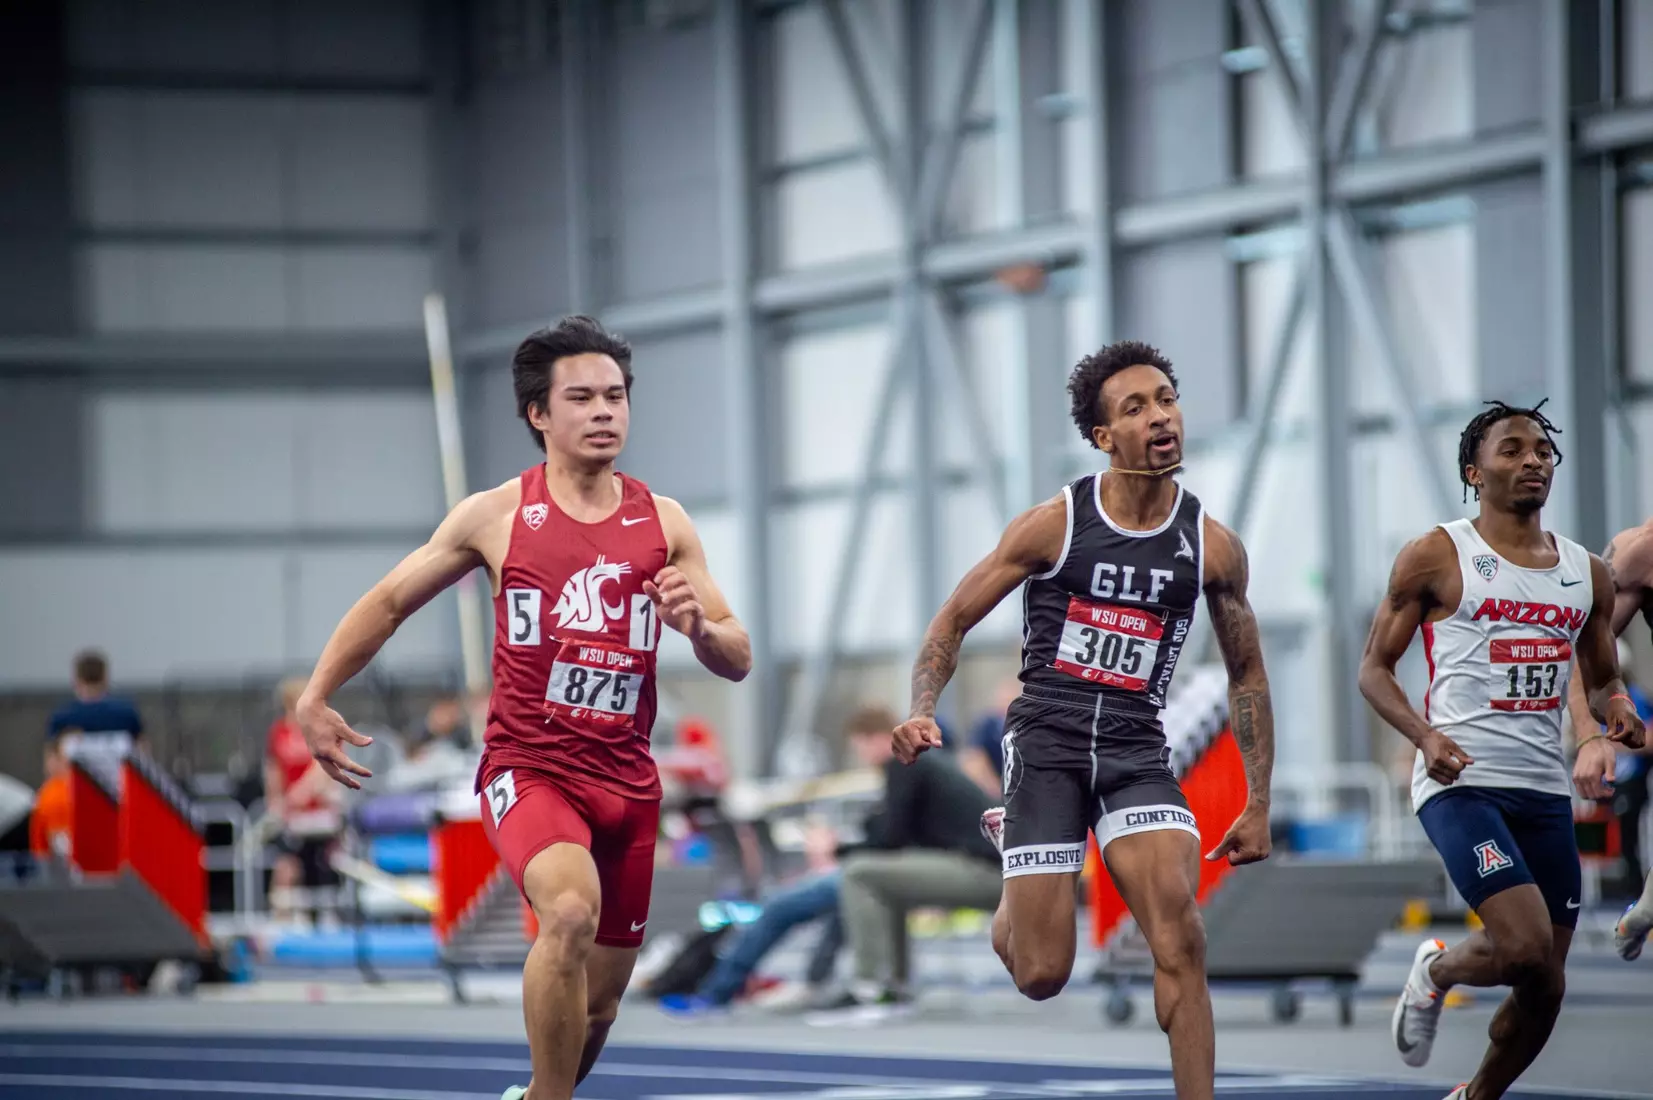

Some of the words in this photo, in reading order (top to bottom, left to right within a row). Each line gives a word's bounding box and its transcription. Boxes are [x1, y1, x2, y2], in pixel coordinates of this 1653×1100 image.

[528, 513, 543, 525] 12
[1090, 562, 1174, 603] GLF
[1482, 568, 1493, 577] 12
[513, 592, 532, 642] 5
[639, 598, 652, 648] 1
[1091, 607, 1118, 626] WSU
[1119, 614, 1148, 632] OPEN
[579, 647, 605, 664] WSU
[607, 650, 634, 668] OPEN
[1074, 627, 1146, 675] 305
[1511, 645, 1534, 658] WSU
[1537, 645, 1558, 658] OPEN
[564, 667, 631, 711] 875
[1506, 664, 1558, 698] 153
[491, 775, 509, 820] 5
[1125, 809, 1196, 828] CONFIDE
[1007, 849, 1081, 869] EXPLOSIVE
[1473, 839, 1514, 878] A
